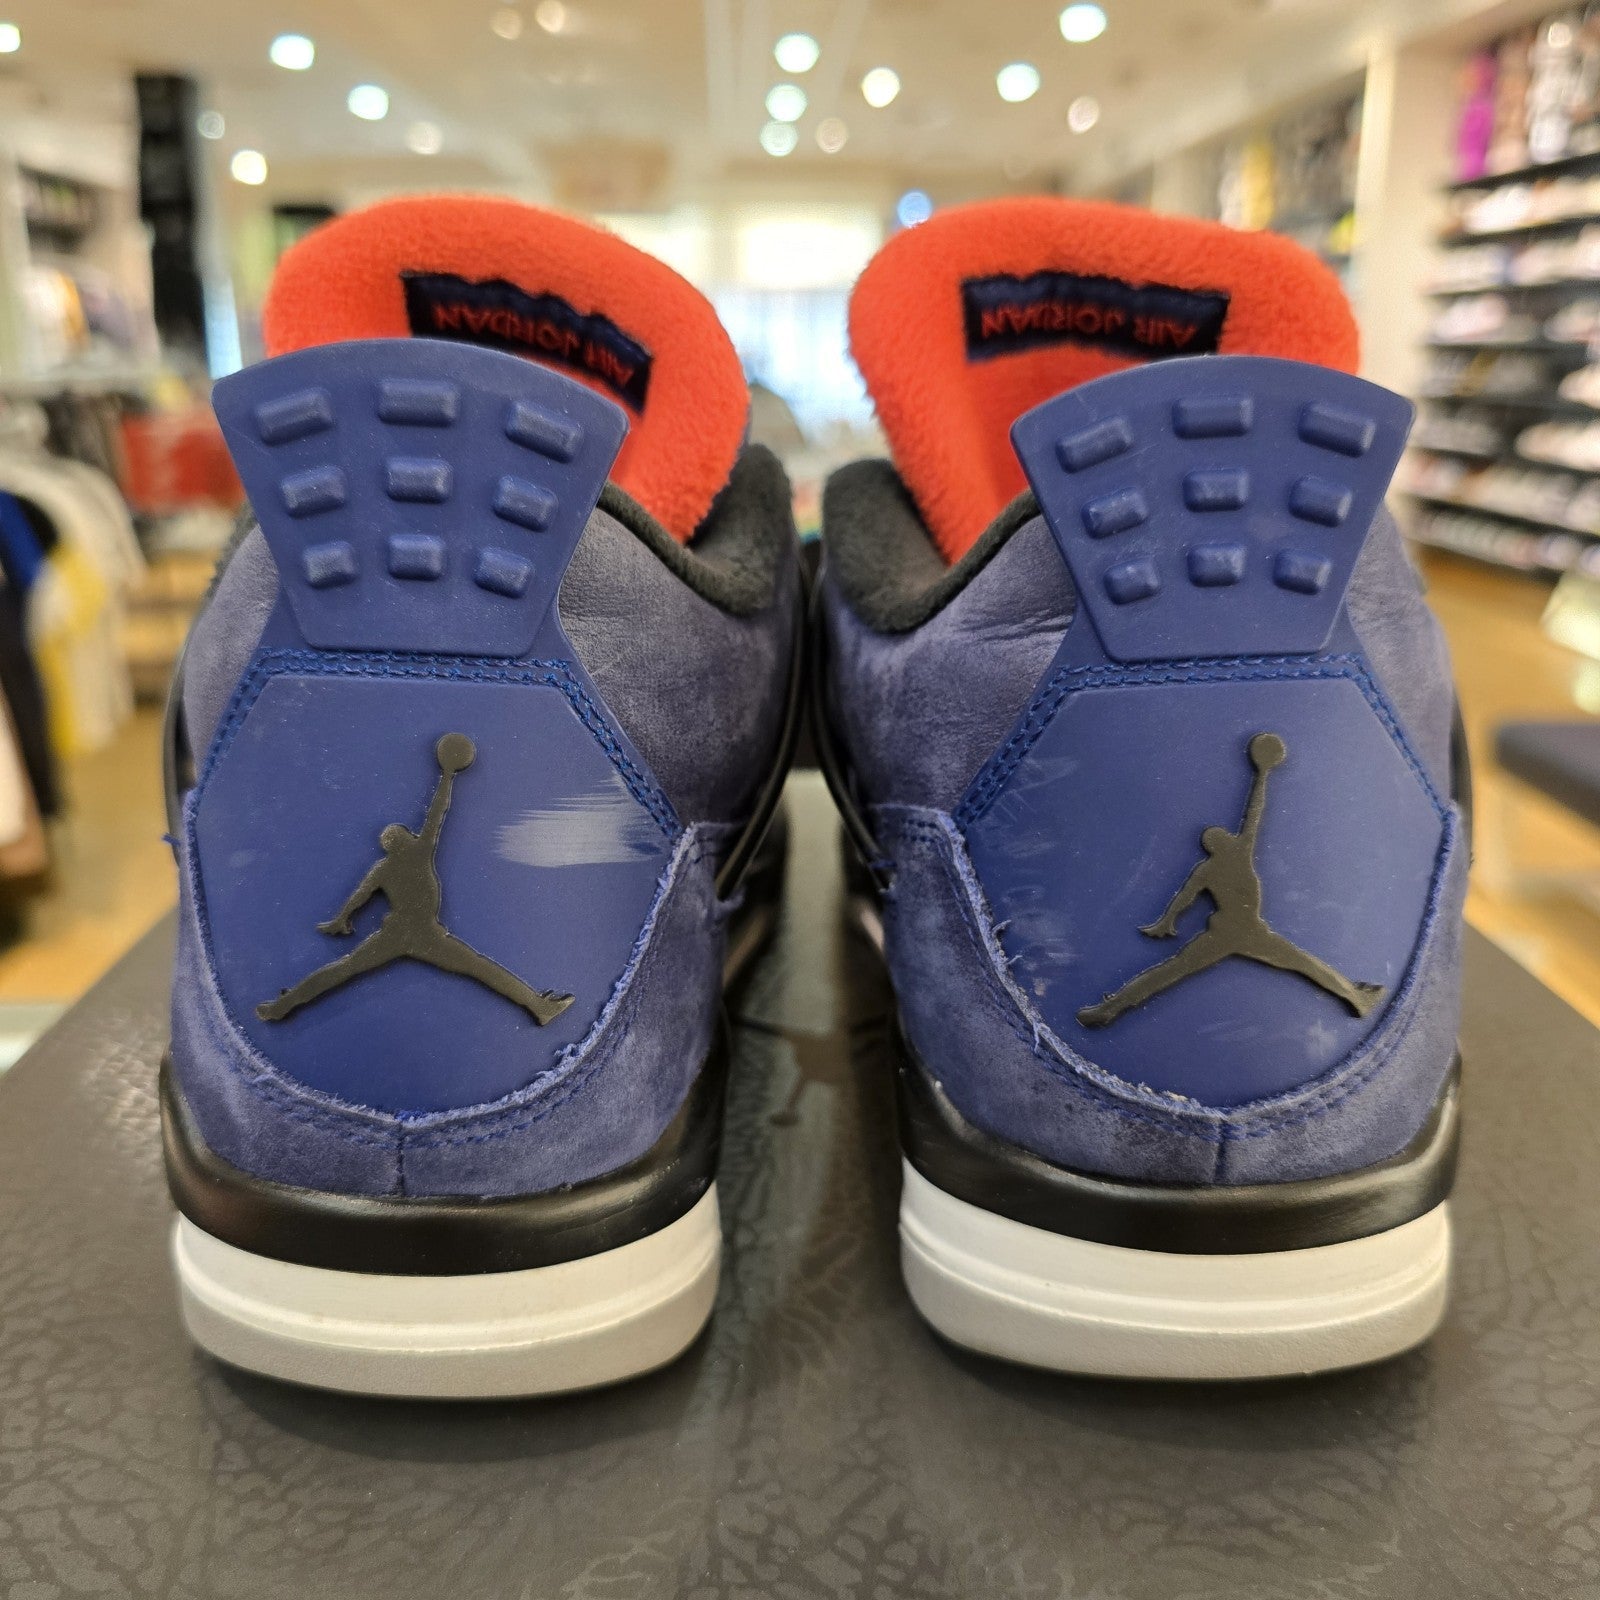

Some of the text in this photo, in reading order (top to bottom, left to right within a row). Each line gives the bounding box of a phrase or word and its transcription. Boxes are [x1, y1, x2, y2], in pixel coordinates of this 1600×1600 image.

[435, 304, 633, 386] AIR JORDAN
[982, 304, 1197, 346] AIR JORDAN
